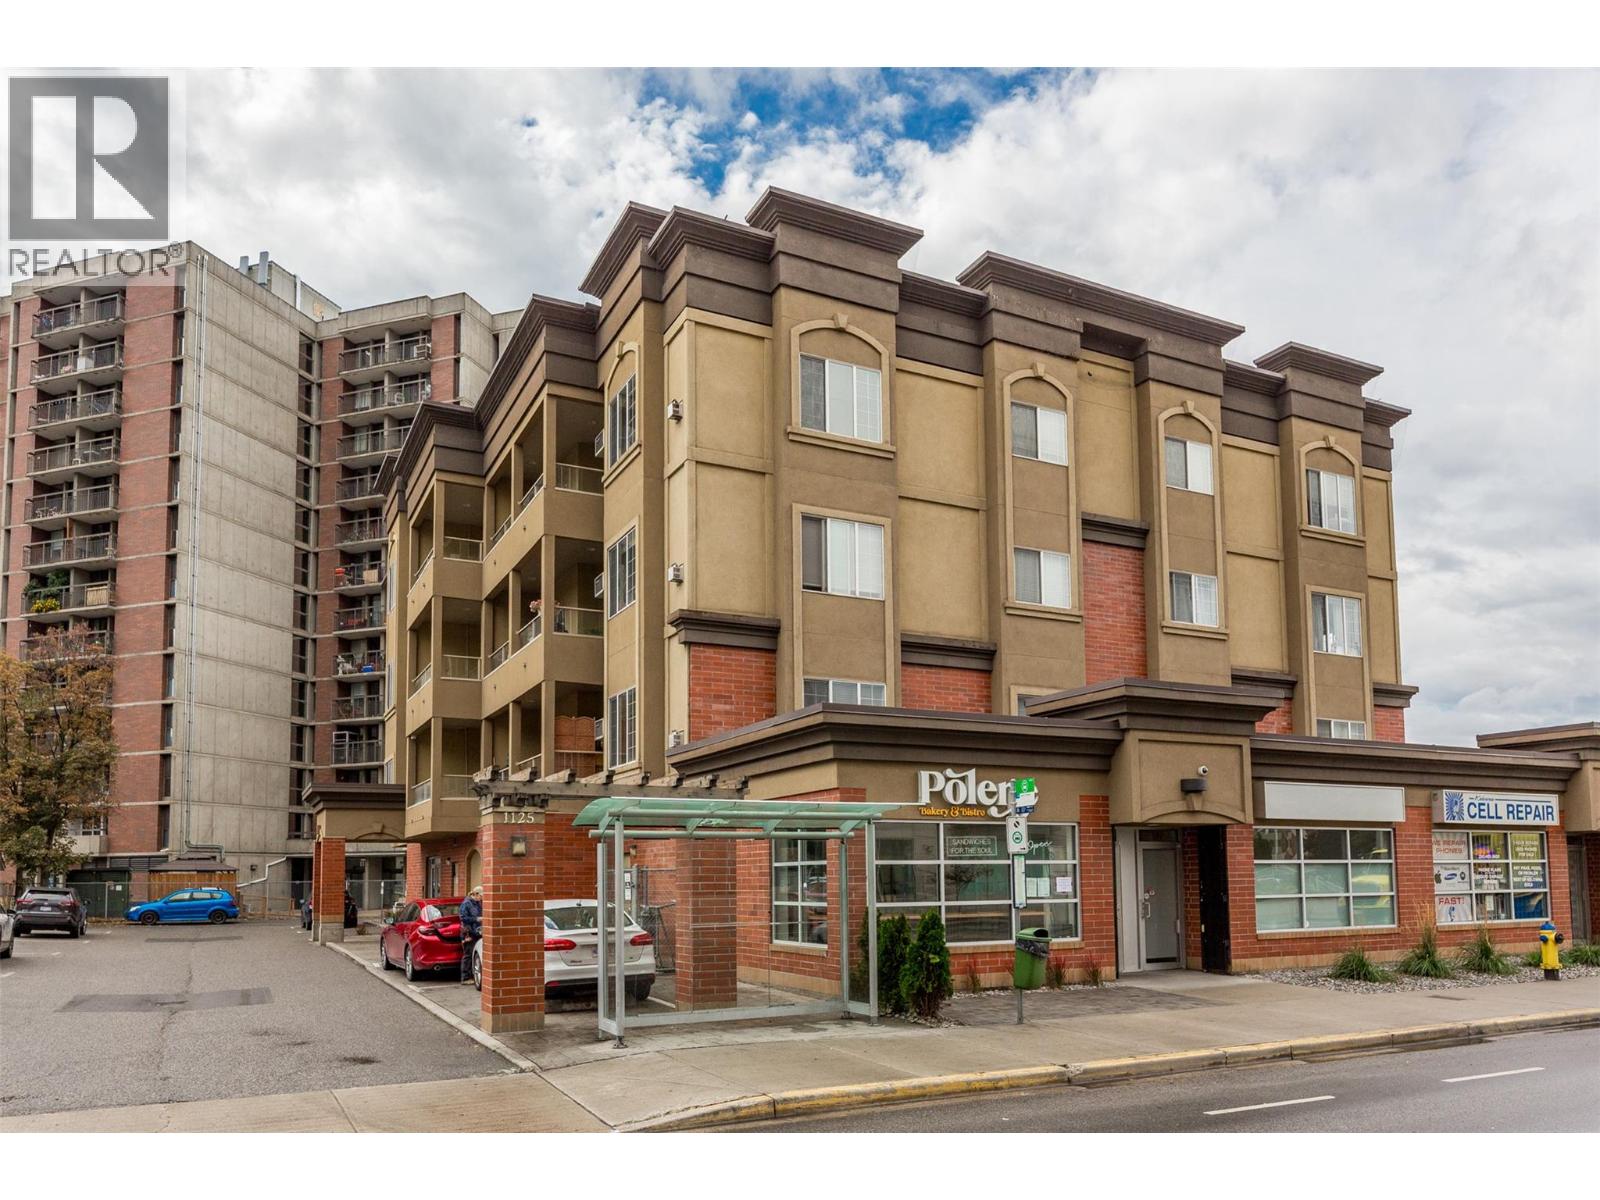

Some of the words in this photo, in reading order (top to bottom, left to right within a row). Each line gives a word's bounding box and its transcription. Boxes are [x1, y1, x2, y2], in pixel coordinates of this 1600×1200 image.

[919, 806, 949, 817] Bakery
[950, 807, 960, 817] &
[960, 807, 986, 817] Bistro
[1467, 802, 1503, 819] CELL
[1506, 803, 1555, 821] REPAIR
[503, 812, 535, 823] 1125
[951, 838, 992, 846] SANDWICHES
[1438, 896, 1465, 905] FAST!
